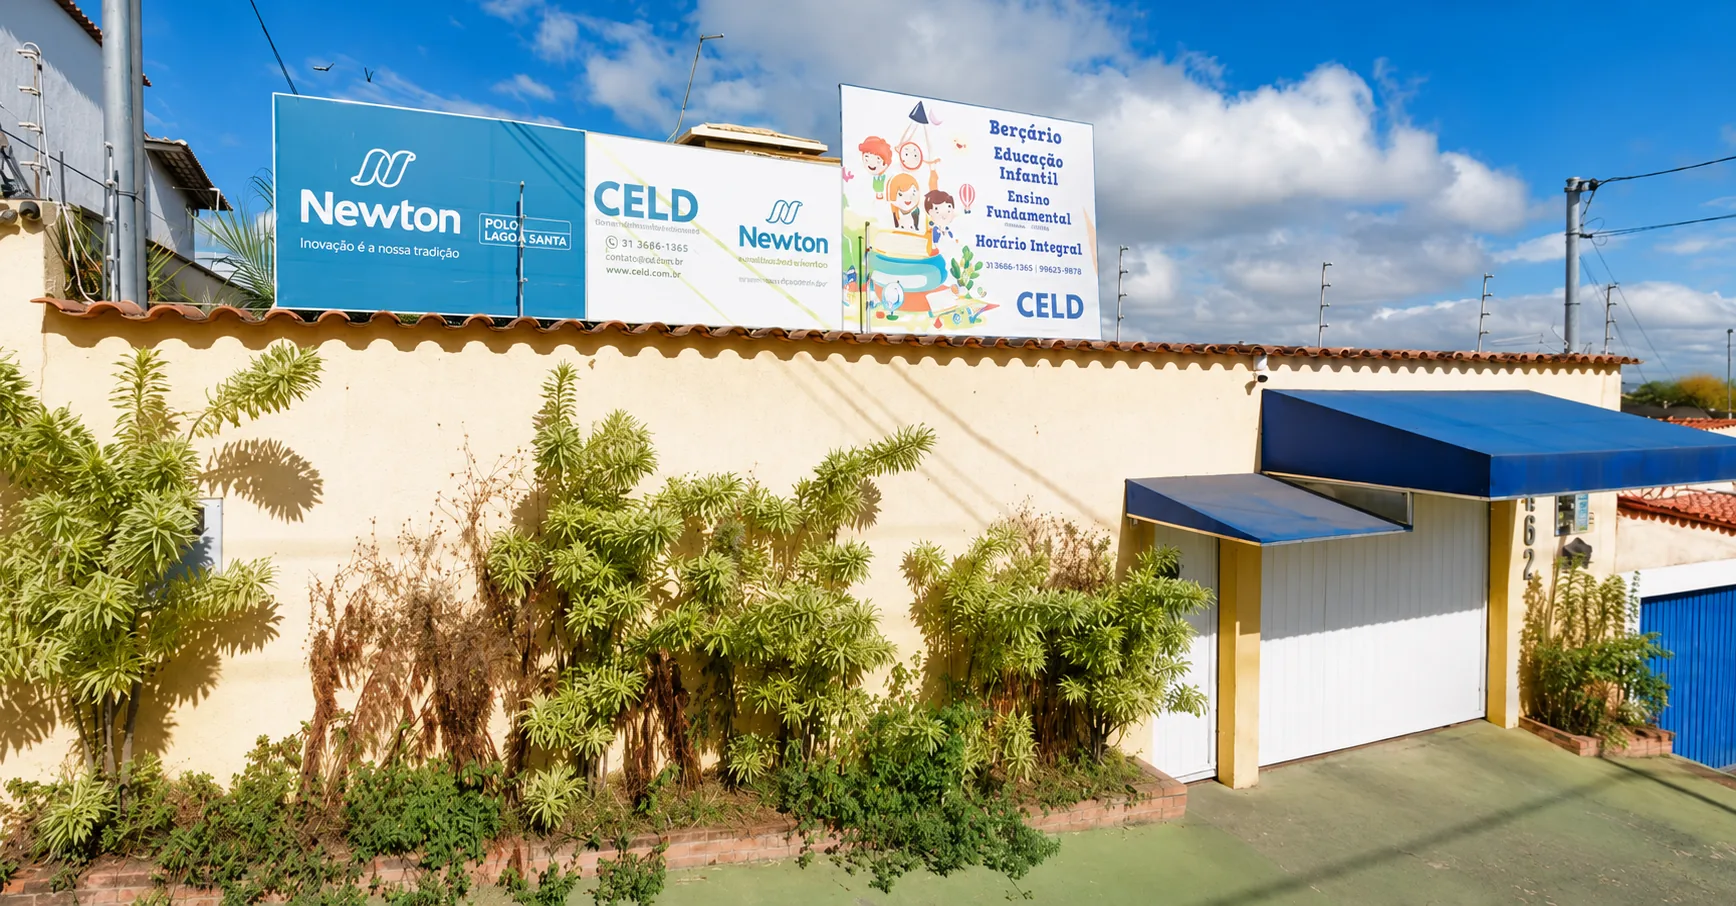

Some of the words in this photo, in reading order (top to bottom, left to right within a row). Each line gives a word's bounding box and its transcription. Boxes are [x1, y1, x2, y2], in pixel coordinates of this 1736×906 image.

[989, 119, 1062, 145] Berçário
[993, 146, 1064, 169] Educação
[999, 166, 1059, 186] Infantil
[593, 180, 698, 223] CELD
[1007, 190, 1050, 206] Ensino
[300, 188, 461, 234] Newton
[986, 205, 1072, 225] Fundamental
[485, 218, 519, 231] POLO
[300, 237, 355, 253] Inovação
[357, 240, 365, 252] é
[368, 243, 375, 253] a
[378, 244, 411, 256] nossa
[413, 244, 460, 260] tradição
[529, 234, 567, 246] SANTA
[621, 239, 633, 248] 31
[739, 224, 829, 254] Newton
[975, 234, 1027, 251] Horário
[1030, 239, 1083, 258] Integral
[606, 267, 681, 278] www.celd.com.br
[1016, 291, 1084, 320] CELD
